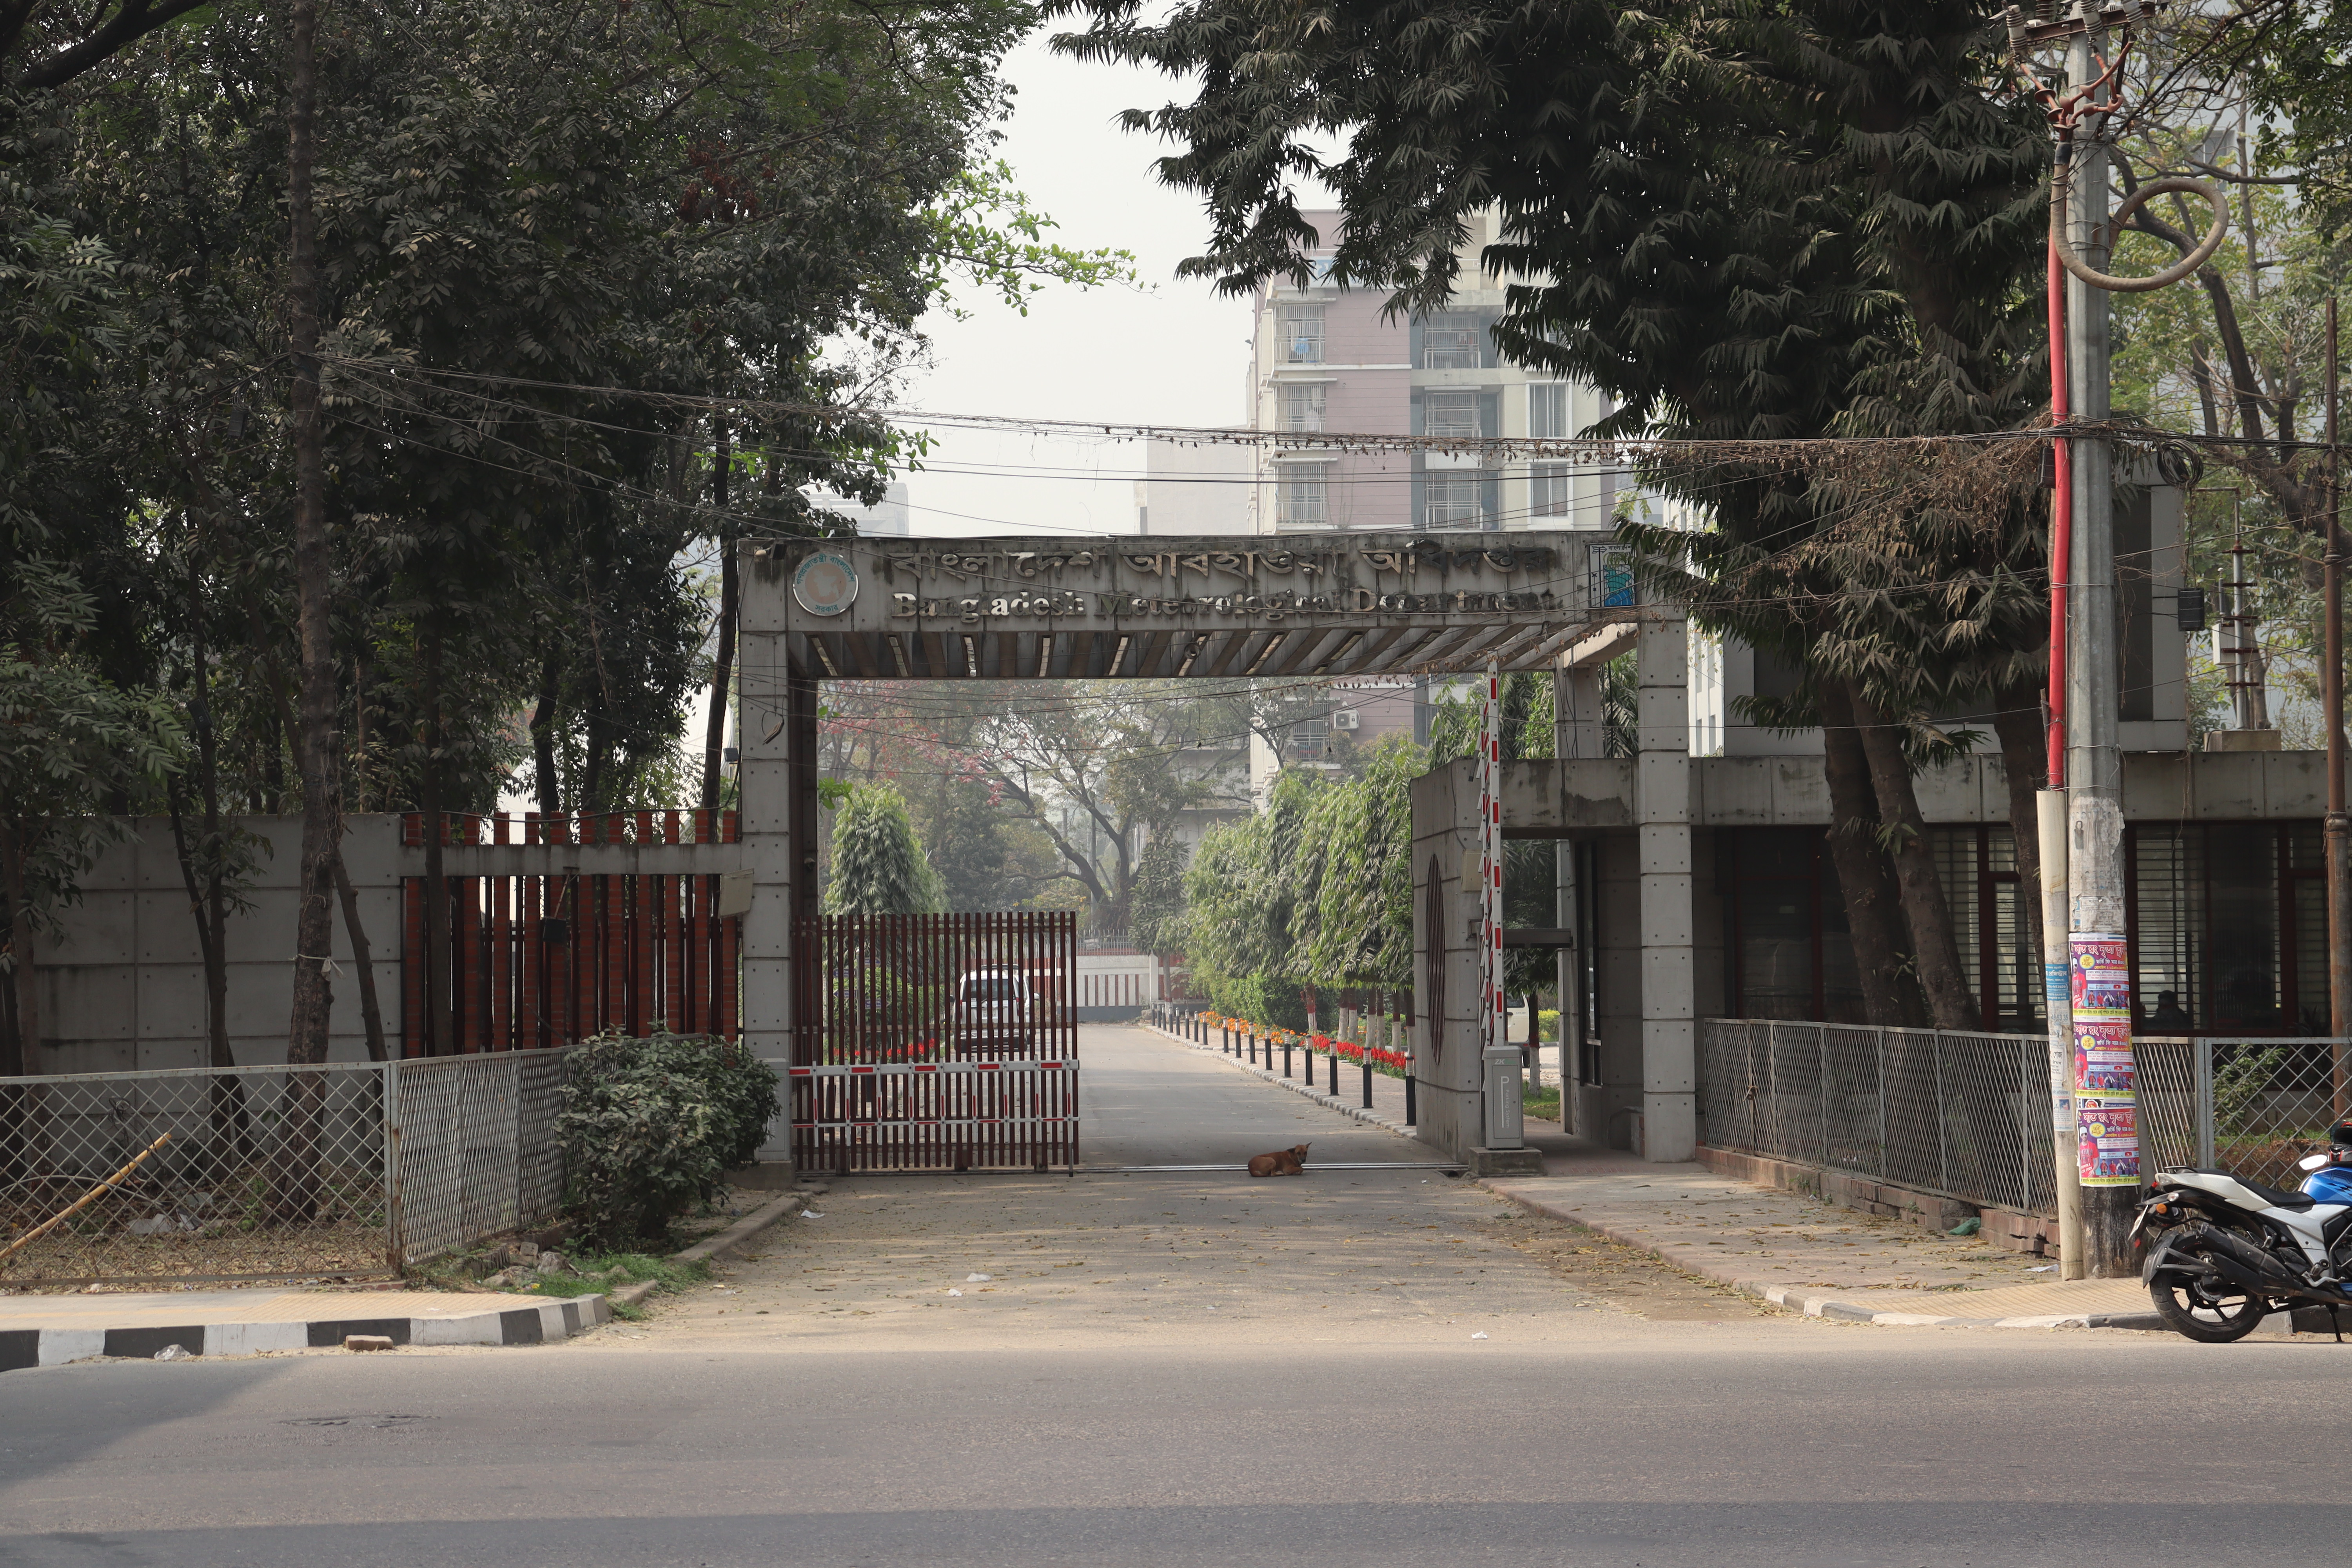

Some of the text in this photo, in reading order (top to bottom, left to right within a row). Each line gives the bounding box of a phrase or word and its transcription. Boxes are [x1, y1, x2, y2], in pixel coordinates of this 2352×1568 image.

[797, 554, 855, 584] গণপ্রজাতন্ত্রী বাংলাদেশ
[888, 548, 1108, 581] বাংলাদেশ
[892, 592, 1086, 623] Bangladesh
[1094, 590, 1343, 621] Meteorological
[2074, 944, 2087, 955] সাত
[2087, 944, 2099, 955] রং
[2098, 944, 2115, 958] নৃত্য
[2076, 1024, 2088, 1035] সাত
[2088, 1025, 2100, 1036] রং
[2099, 1026, 2116, 1039] নৃত্য
[2083, 1112, 2097, 1123] সাত
[2097, 1113, 2109, 1123] রং
[2108, 1112, 2125, 1126] নৃত্য
